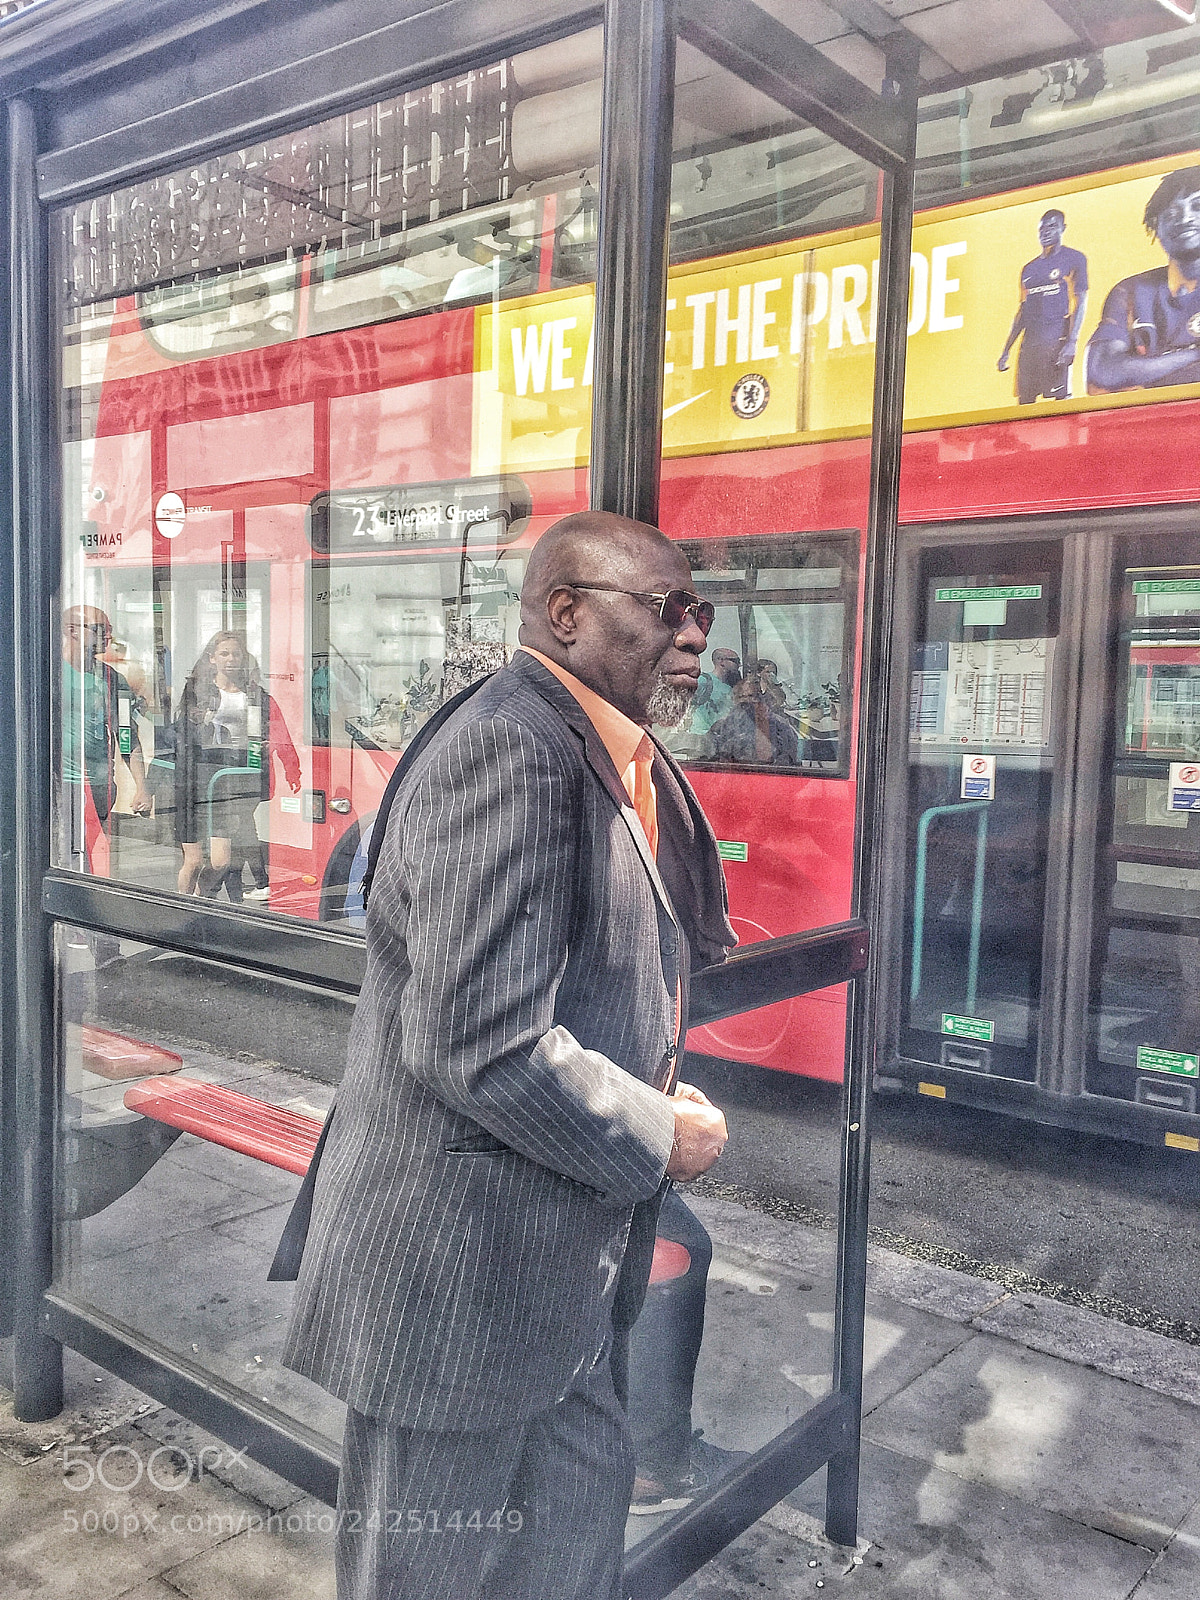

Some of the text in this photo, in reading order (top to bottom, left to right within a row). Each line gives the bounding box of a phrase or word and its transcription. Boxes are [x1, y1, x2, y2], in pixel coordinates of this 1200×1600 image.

[685, 278, 782, 370] THE
[511, 317, 577, 397] WE
[352, 506, 381, 536] 23
[446, 505, 490, 524] Street
[1014, 587, 1038, 597] EXIT
